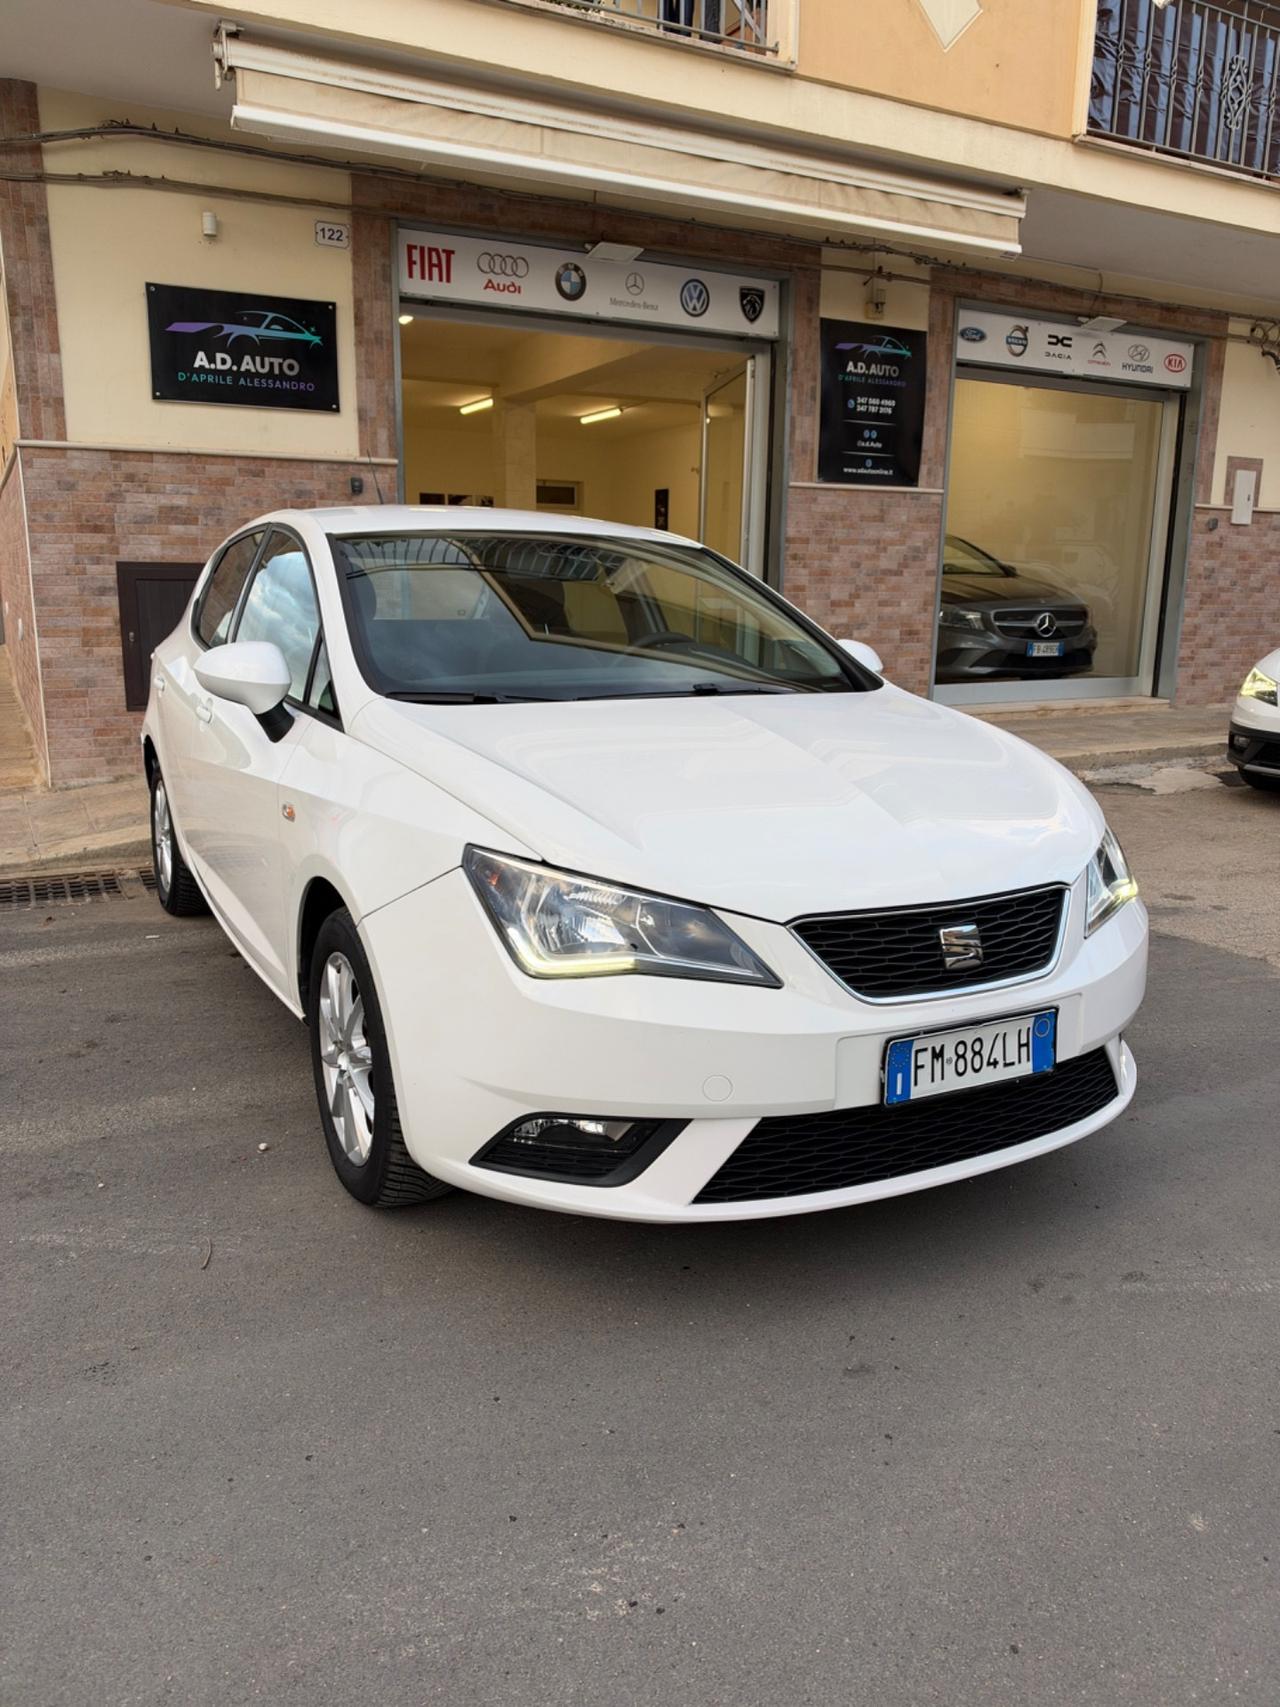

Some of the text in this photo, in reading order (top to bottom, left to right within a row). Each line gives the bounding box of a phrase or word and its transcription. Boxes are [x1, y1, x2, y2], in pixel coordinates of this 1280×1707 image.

[319, 227, 344, 242] 122
[406, 244, 456, 283] FIAT
[483, 278, 522, 294] Audi
[1121, 362, 1154, 374] HYUNDAI
[1167, 357, 1184, 369] KIA
[177, 371, 315, 392] D'APRILE ALESSANDRO
